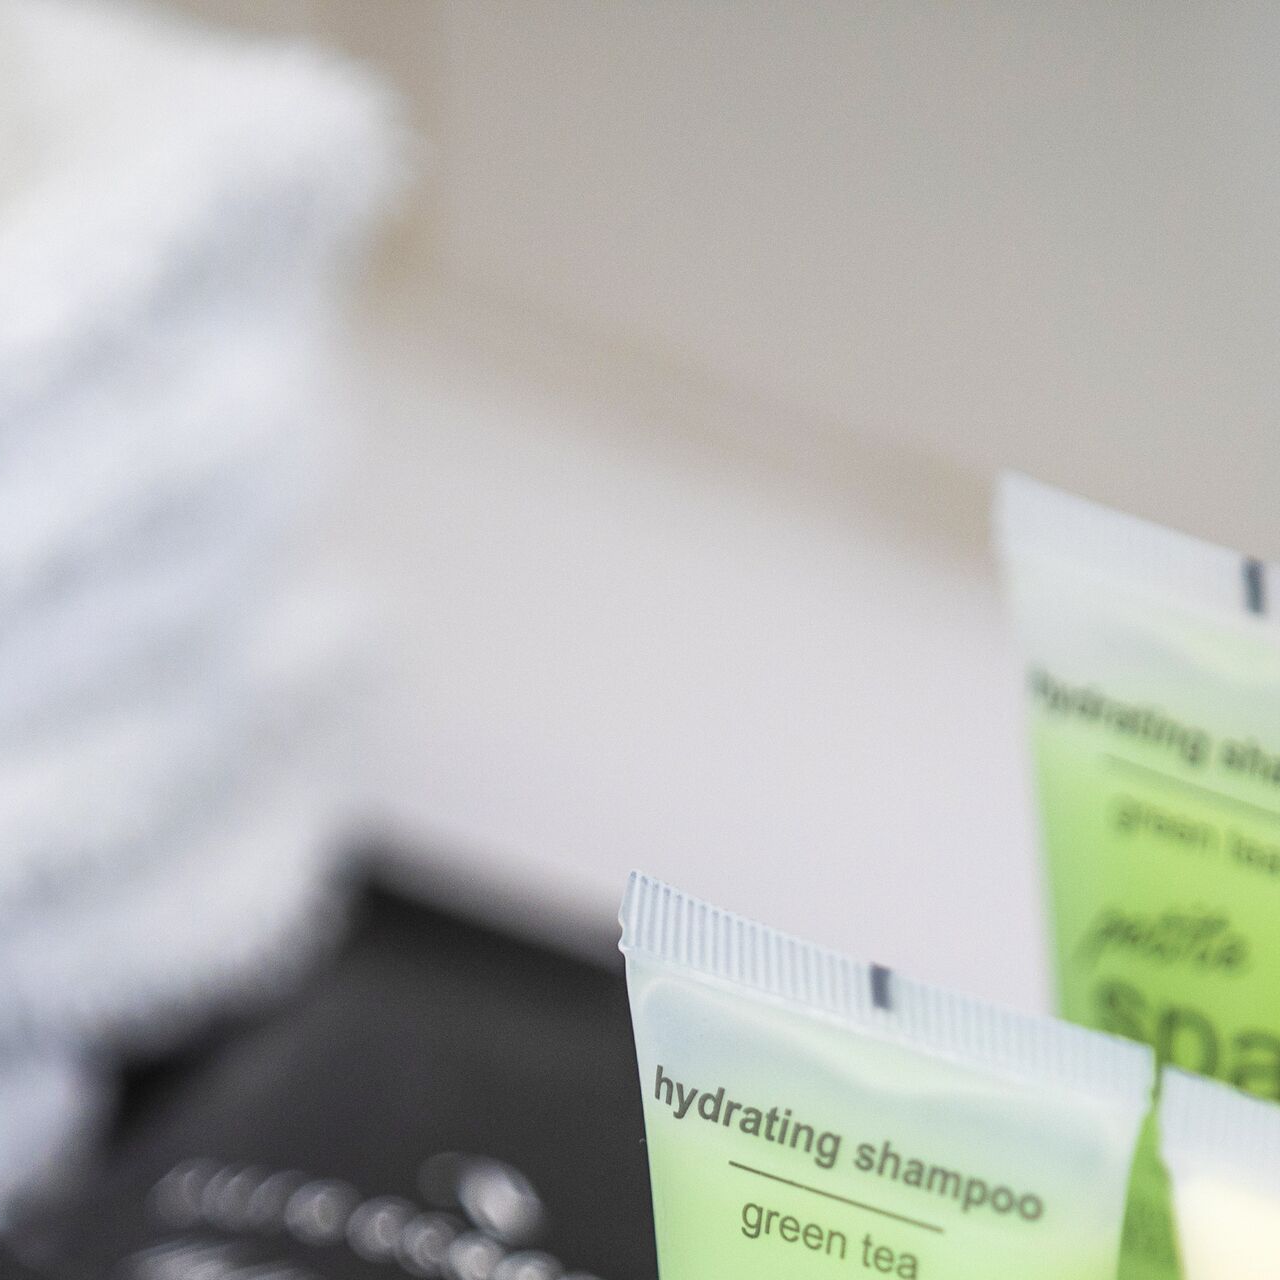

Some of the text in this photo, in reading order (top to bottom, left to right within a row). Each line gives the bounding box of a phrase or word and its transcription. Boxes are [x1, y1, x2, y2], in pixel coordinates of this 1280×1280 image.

[653, 1064, 1045, 1222] hydrating shampoo
[740, 1201, 847, 1260] green
